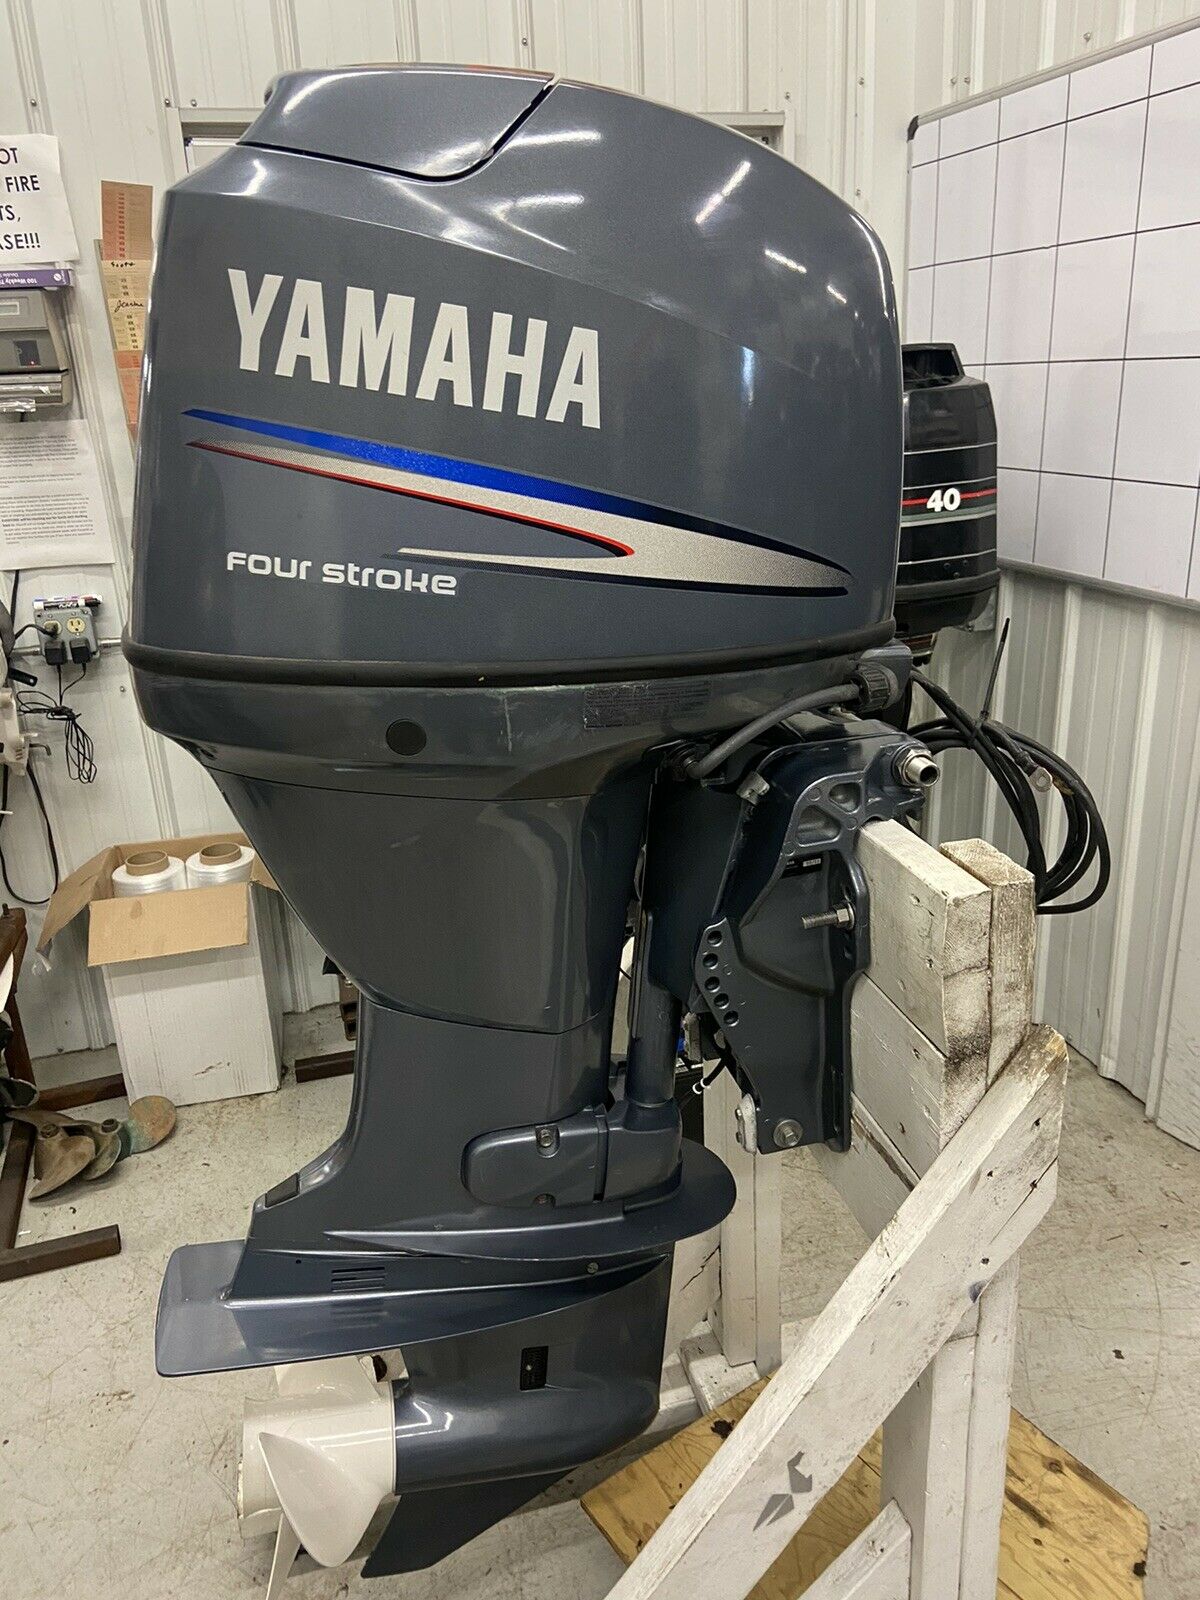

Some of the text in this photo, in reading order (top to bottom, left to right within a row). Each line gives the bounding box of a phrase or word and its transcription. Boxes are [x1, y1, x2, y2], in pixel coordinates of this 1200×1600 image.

[5, 174, 41, 193] FIRE
[227, 268, 601, 429] YAMAHA
[926, 487, 961, 512] 40
